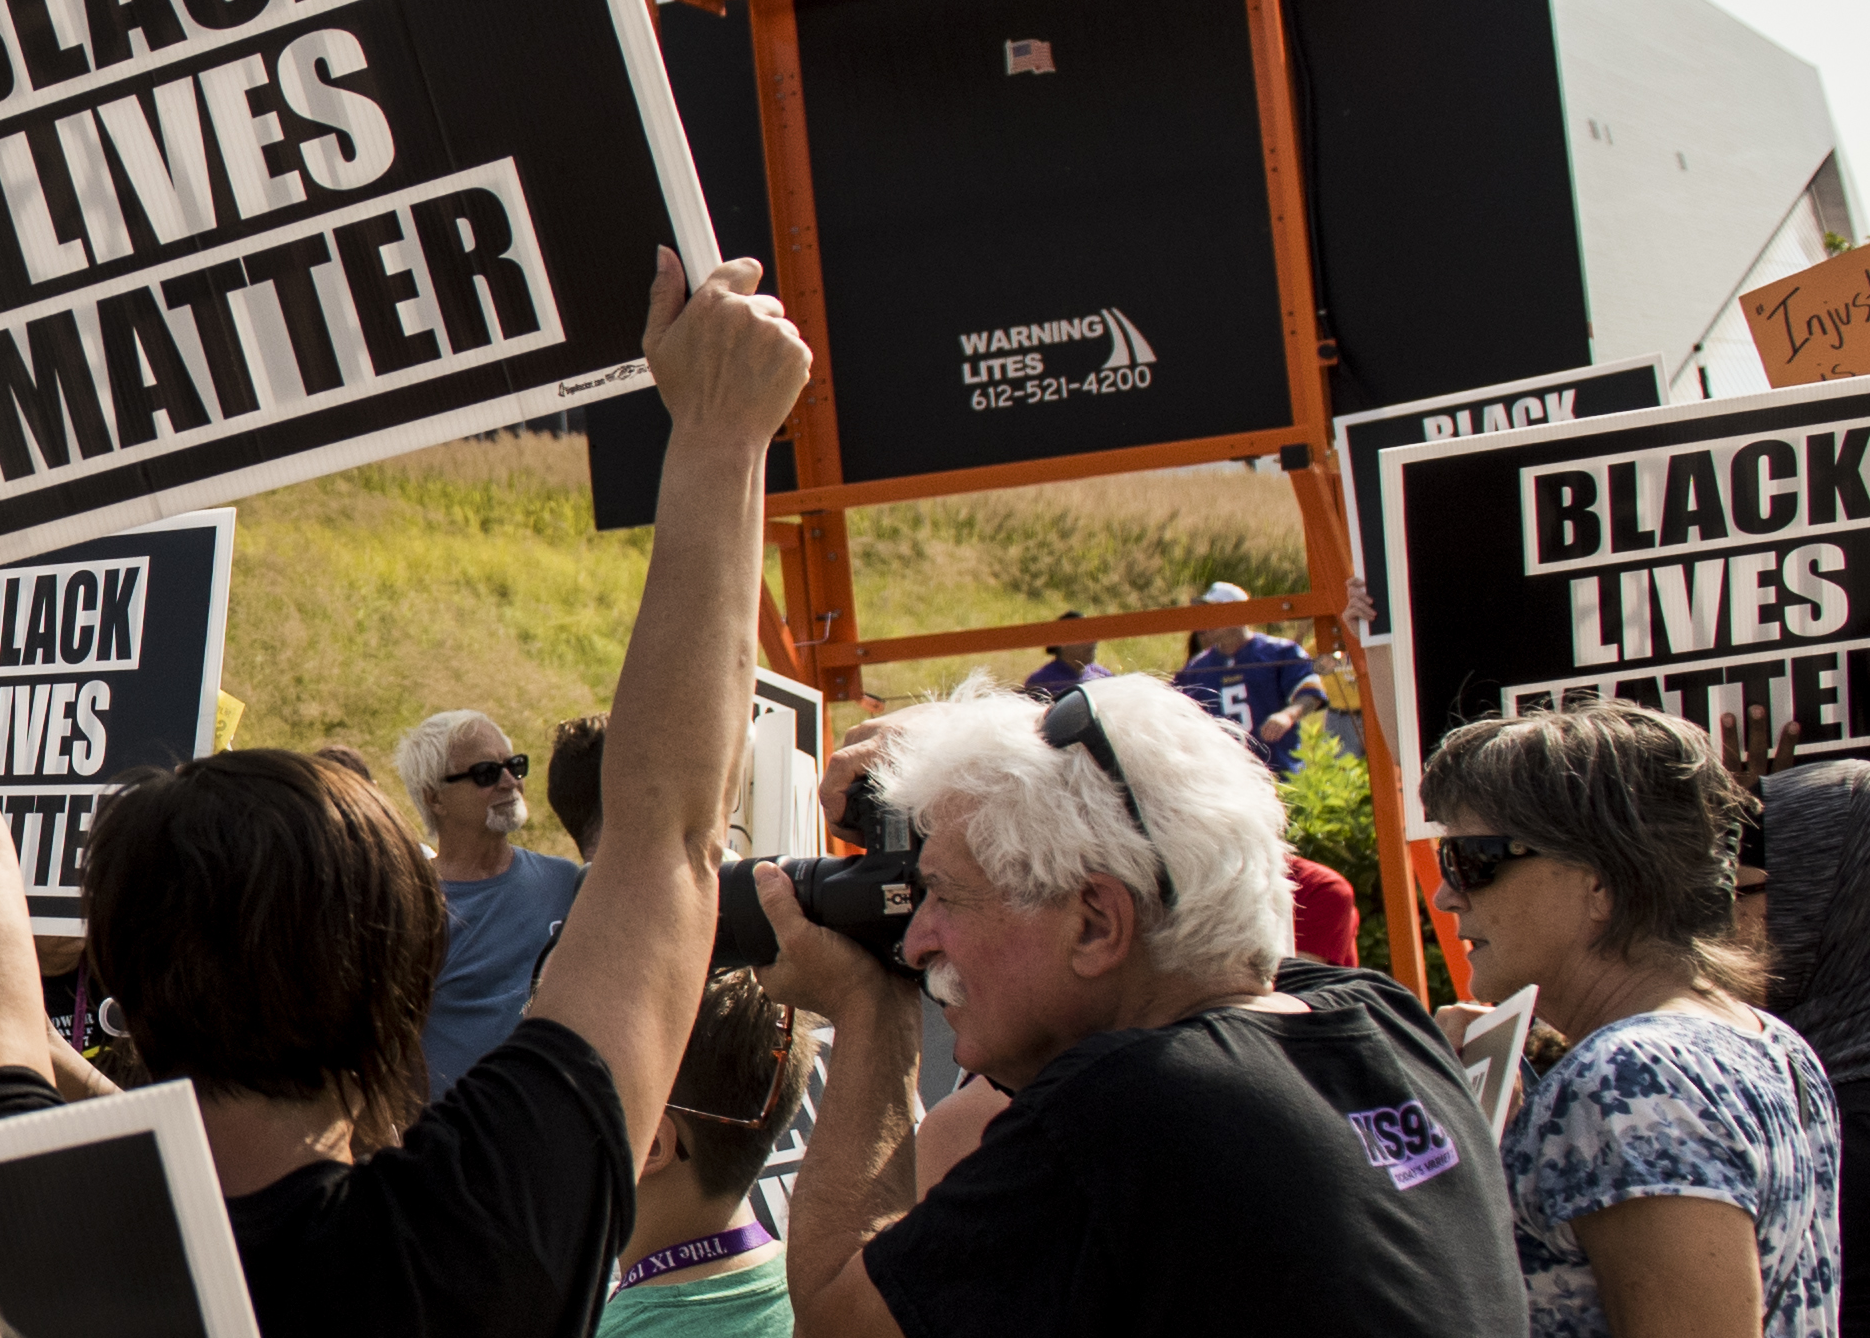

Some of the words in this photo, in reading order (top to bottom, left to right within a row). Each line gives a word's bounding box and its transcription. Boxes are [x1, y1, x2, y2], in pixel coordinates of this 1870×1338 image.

[960, 314, 1104, 356] WARNING
[962, 352, 1044, 385] LITES
[970, 364, 1152, 411] 612-521-4200
[1534, 429, 1870, 564] BLACK
[1570, 542, 1849, 667] LIVES
[650, 1249, 676, 1273] IX
[680, 1237, 728, 1262] Title
